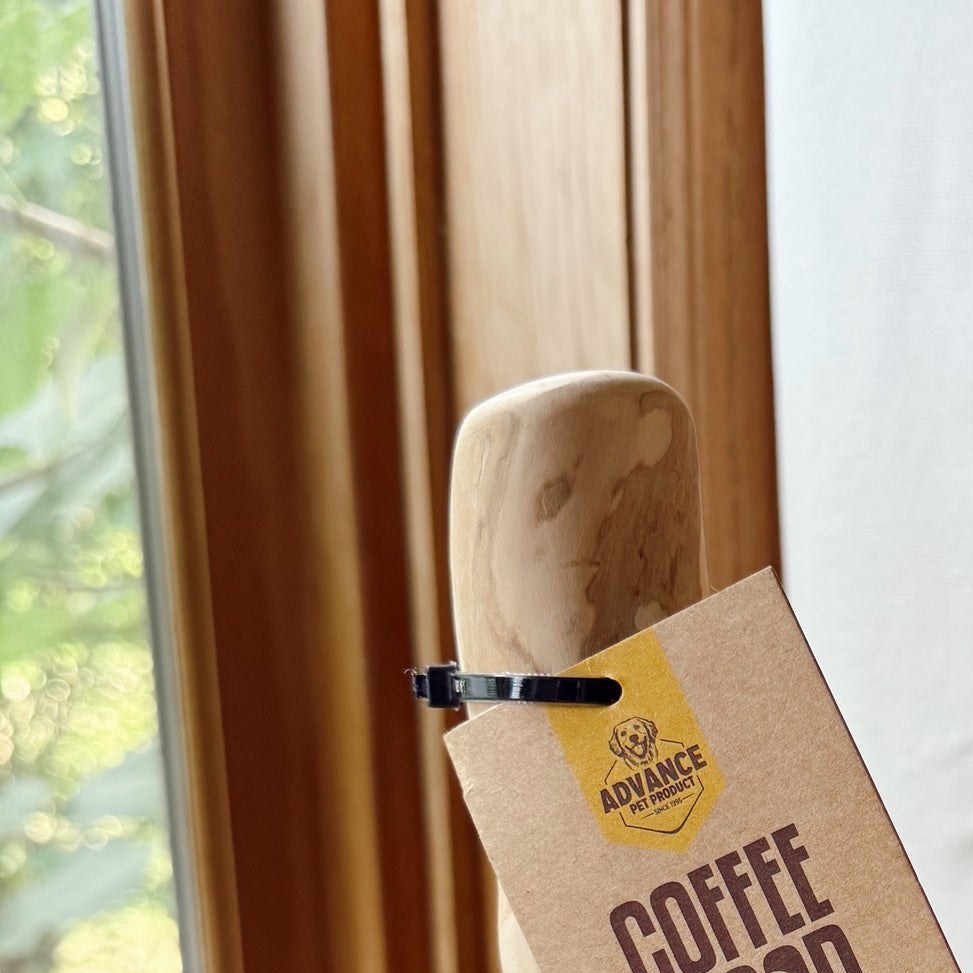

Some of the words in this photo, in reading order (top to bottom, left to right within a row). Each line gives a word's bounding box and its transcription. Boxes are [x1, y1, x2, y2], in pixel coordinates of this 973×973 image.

[600, 744, 707, 814] ADVANCE
[629, 798, 649, 814] PET
[650, 776, 695, 805] PRODUCT
[654, 804, 670, 815] SINCE
[670, 797, 683, 808] 1995
